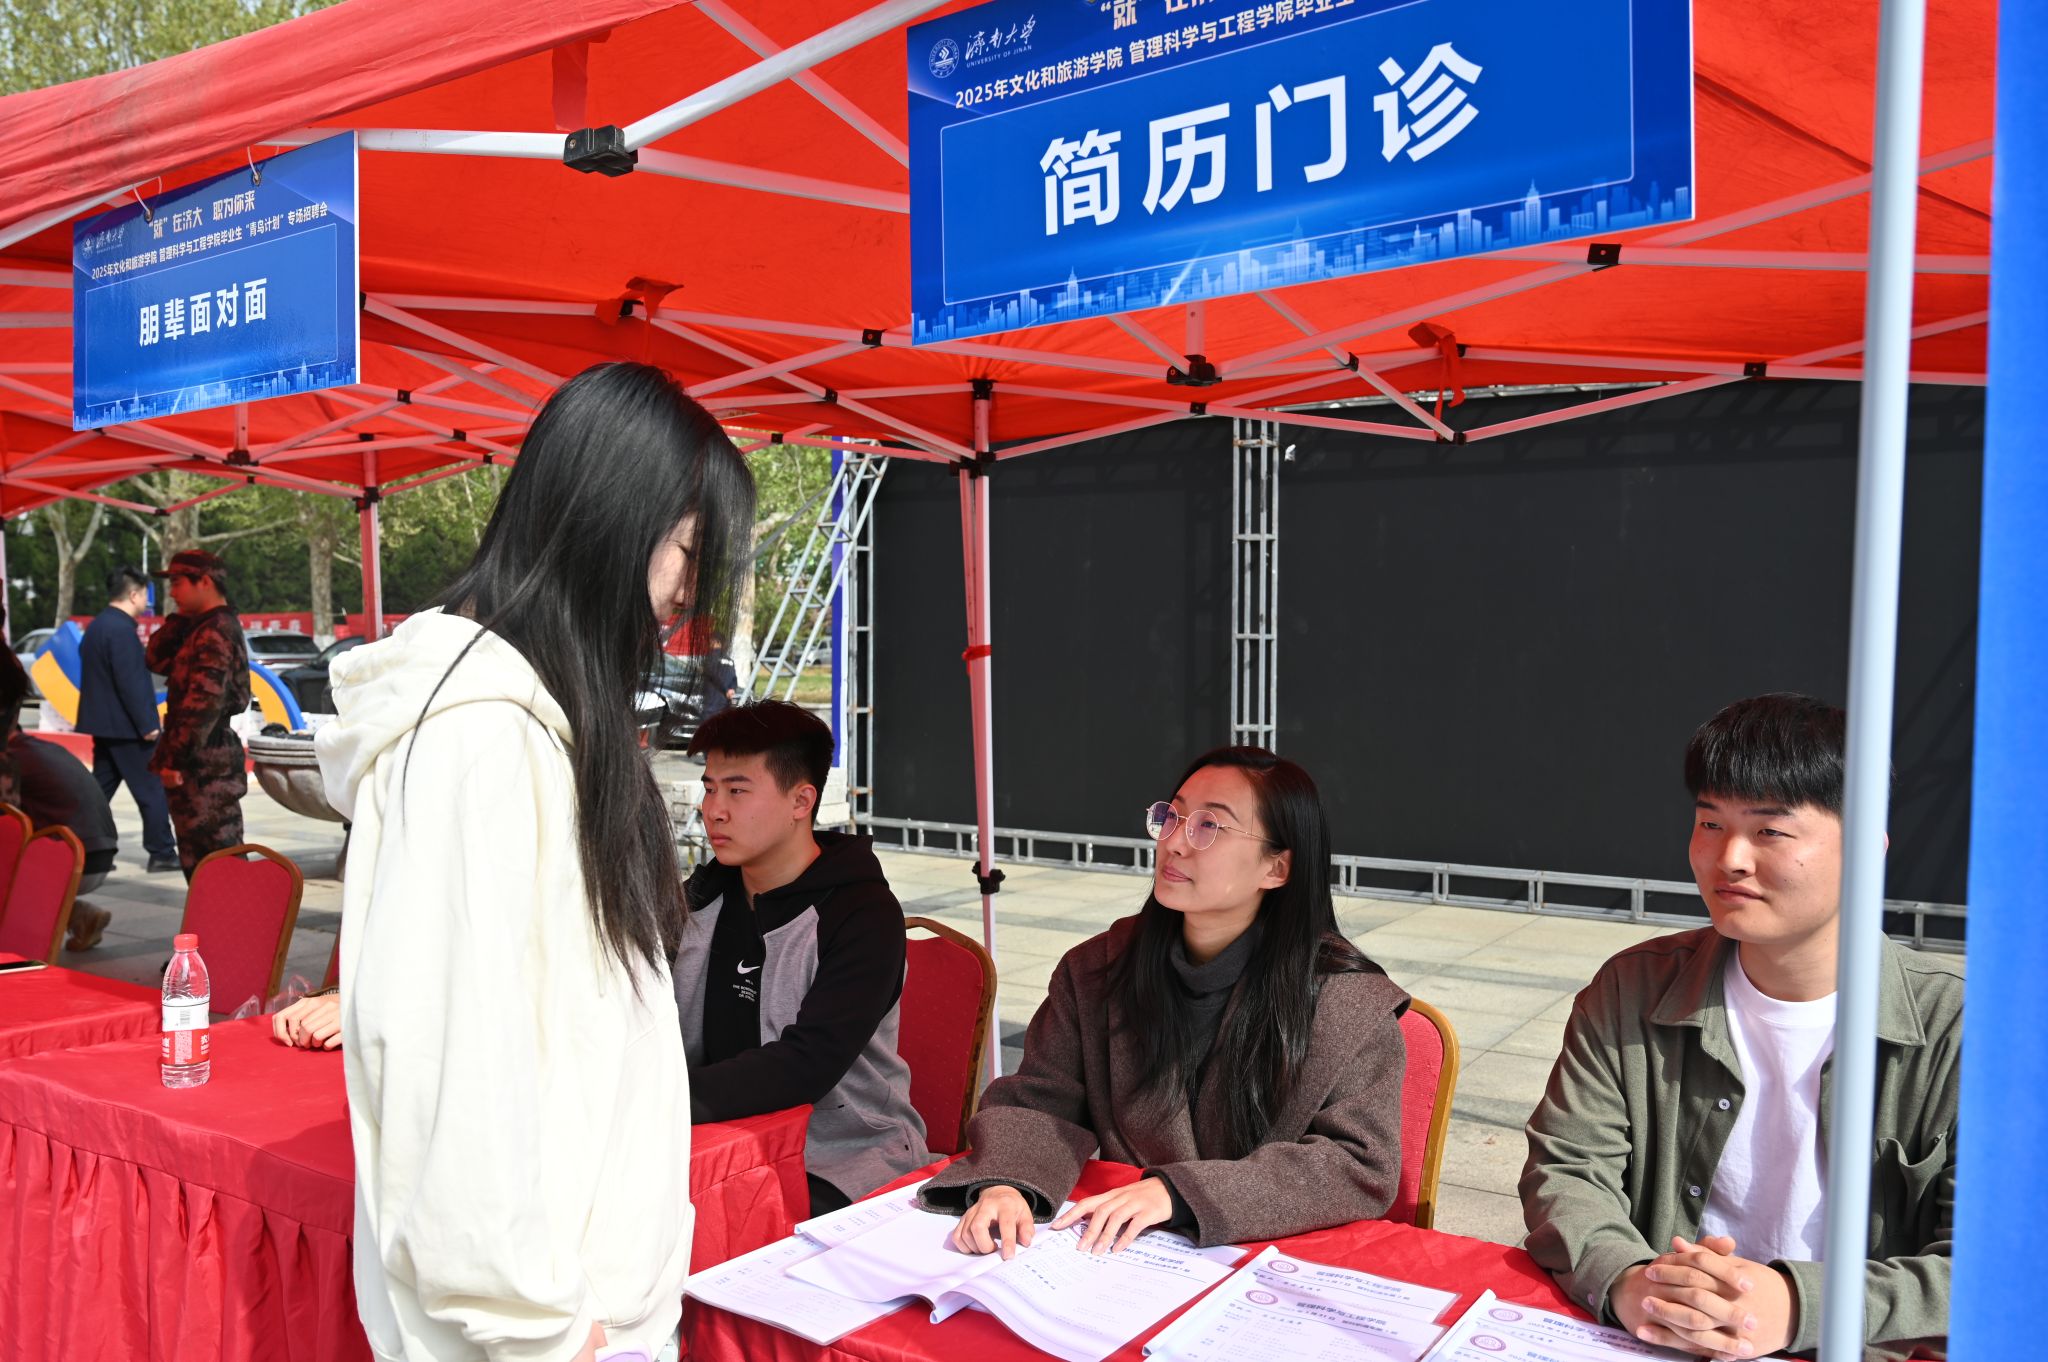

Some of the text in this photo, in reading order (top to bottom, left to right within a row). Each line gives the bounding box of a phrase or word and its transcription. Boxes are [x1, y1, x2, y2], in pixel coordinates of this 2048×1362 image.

[955, 47, 1123, 109] 2025年文化和旅游学院
[966, 53, 1001, 68] UNIVERSITY
[1013, 44, 1032, 55] JINAN
[1039, 42, 1483, 236] 简历门诊
[212, 190, 255, 221] 职为你来
[92, 251, 157, 279] 2025年文化和旅游学院
[139, 277, 267, 347] 朋辈面对面
